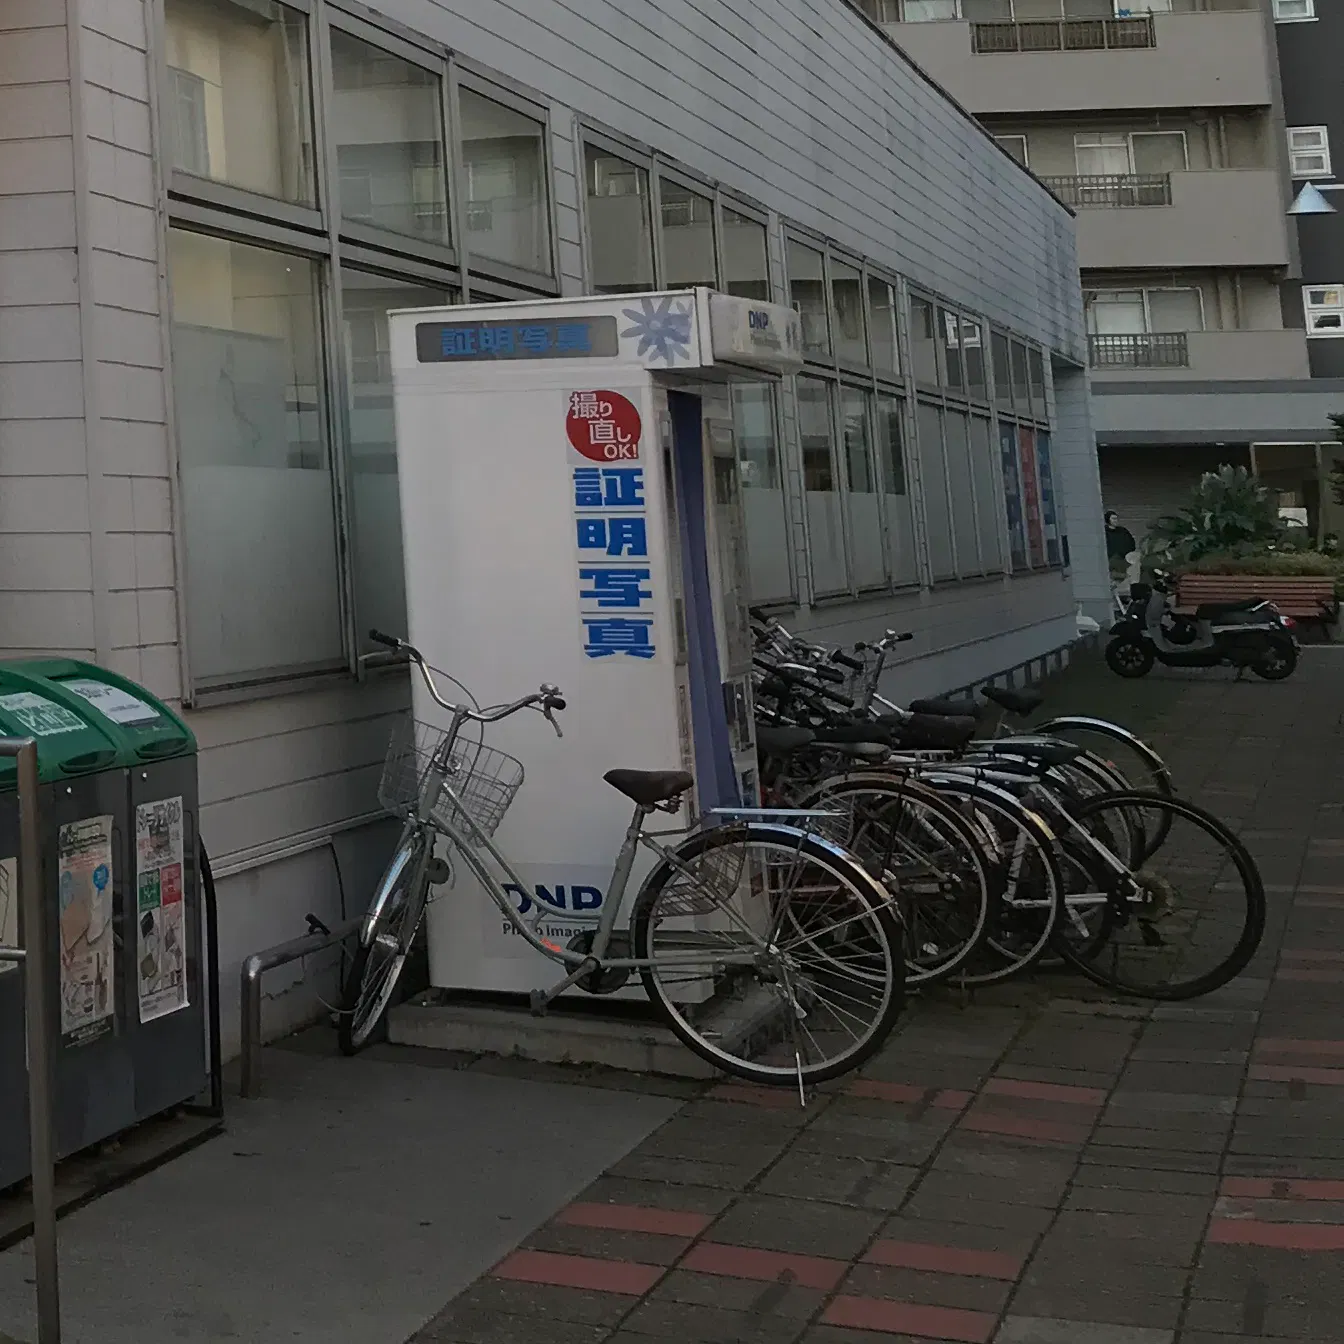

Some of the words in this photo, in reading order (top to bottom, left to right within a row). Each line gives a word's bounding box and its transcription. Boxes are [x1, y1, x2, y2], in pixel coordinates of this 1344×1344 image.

[441, 324, 592, 357] 証明写真
[569, 392, 613, 419] 撮り
[588, 419, 632, 445] 直し
[604, 443, 638, 459] OK!
[572, 467, 656, 659] 証明写真
